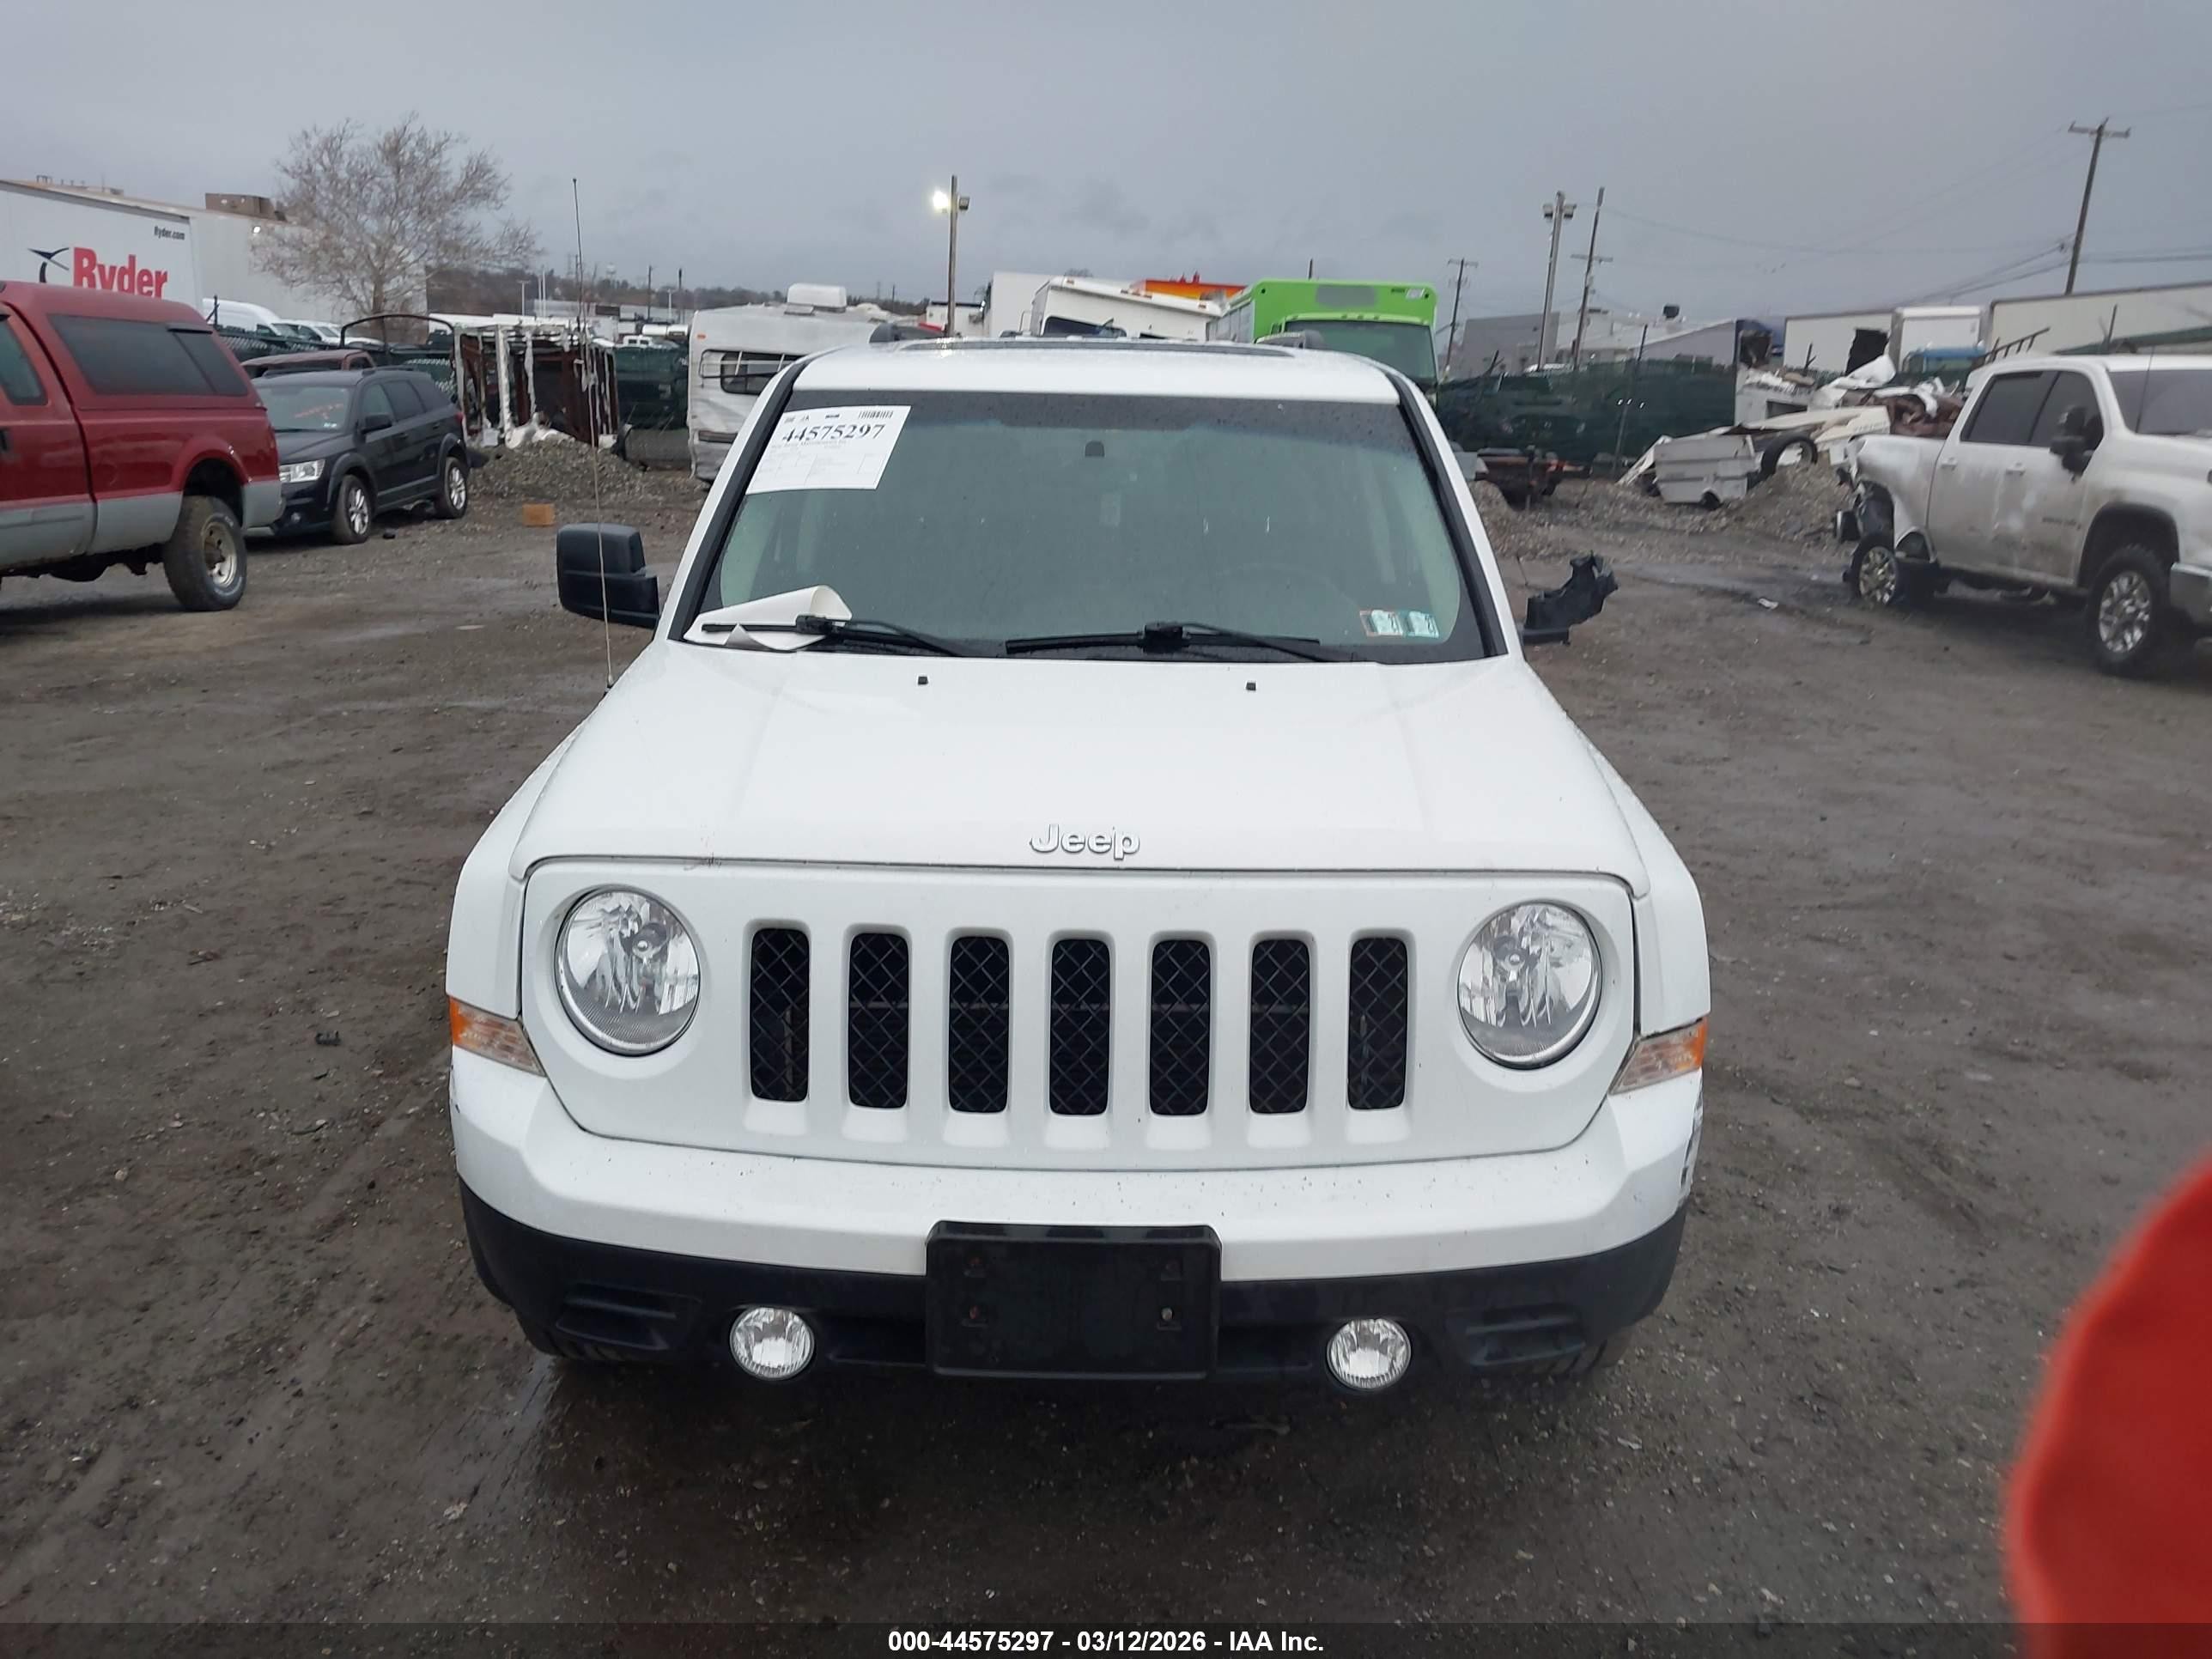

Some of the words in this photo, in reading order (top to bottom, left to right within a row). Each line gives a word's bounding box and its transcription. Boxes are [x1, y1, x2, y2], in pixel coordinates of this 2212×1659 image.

[153, 225, 185, 240] Ryder.com
[74, 247, 168, 298] Ryder
[782, 423, 886, 442] 44575297
[1030, 823, 1140, 861] Jeep
